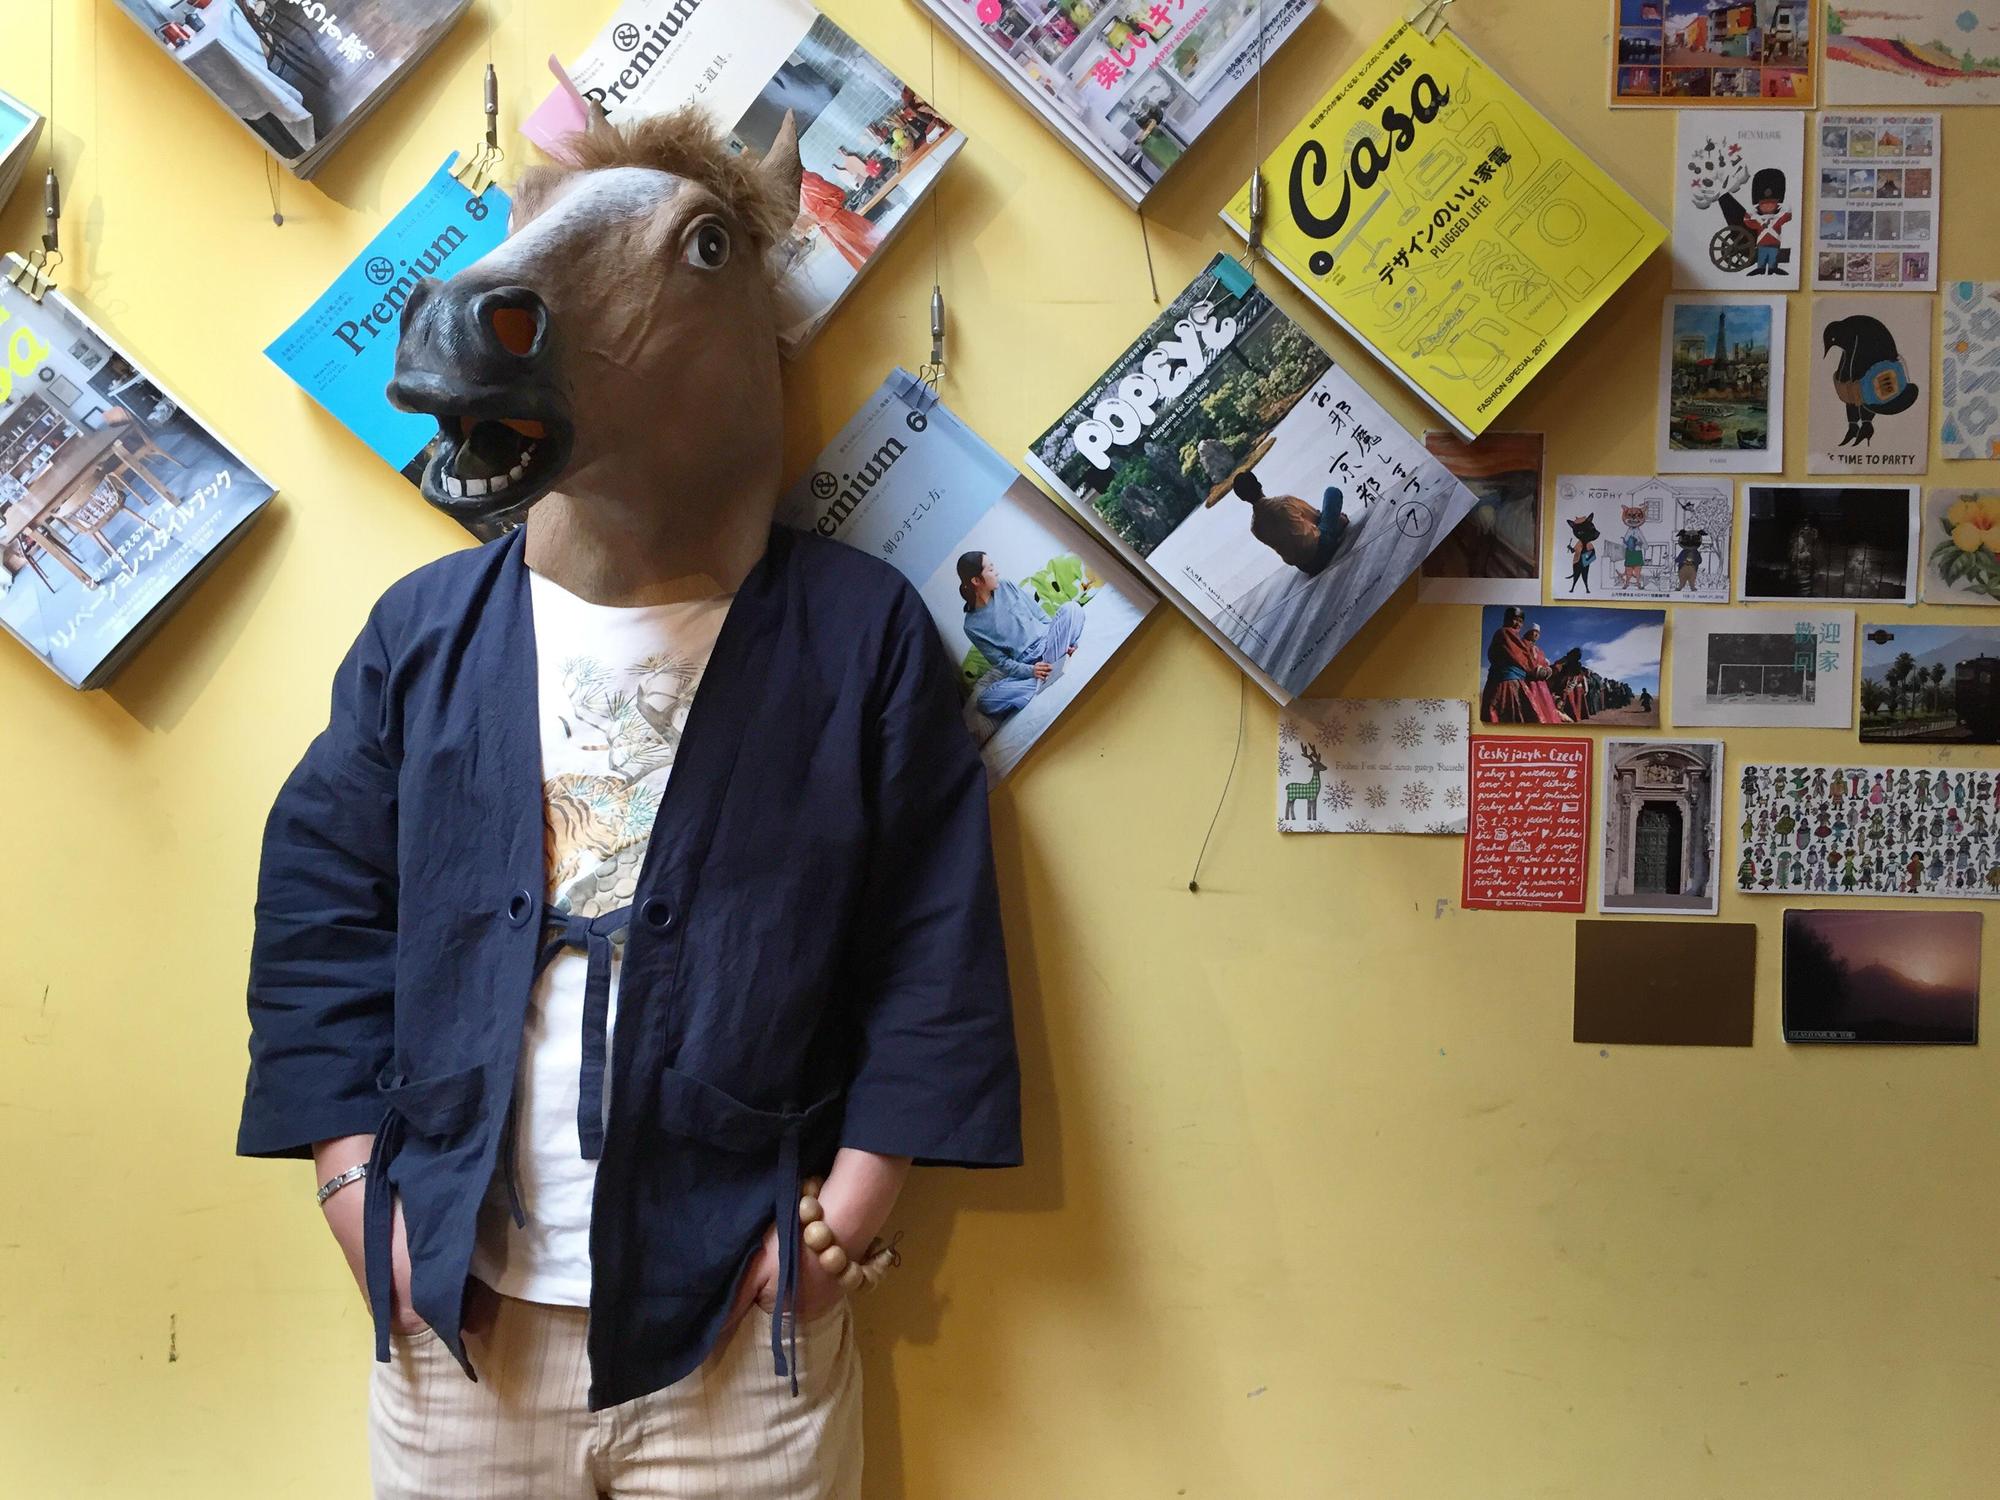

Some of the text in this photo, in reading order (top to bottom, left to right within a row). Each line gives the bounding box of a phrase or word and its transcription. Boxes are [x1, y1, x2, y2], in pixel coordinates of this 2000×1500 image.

[1357, 52, 1413, 111] BRUTUS
[1289, 73, 1450, 239] Casa
[465, 197, 488, 222] 8
[1377, 143, 1512, 285] デザインのいい家電
[1430, 194, 1491, 259] PLUGGED LIFE!
[1073, 300, 1238, 471] POPEYE
[1476, 338, 1548, 413] FASHION SPECIAL 2017
[1149, 377, 1211, 440] Magazine for City Boys
[813, 434, 908, 536] emium
[906, 411, 928, 433] 6
[1838, 455, 1862, 464] TIME
[1866, 455, 1880, 464] TO
[1882, 454, 1916, 464] PARTY
[1549, 748, 1583, 762] Czech
